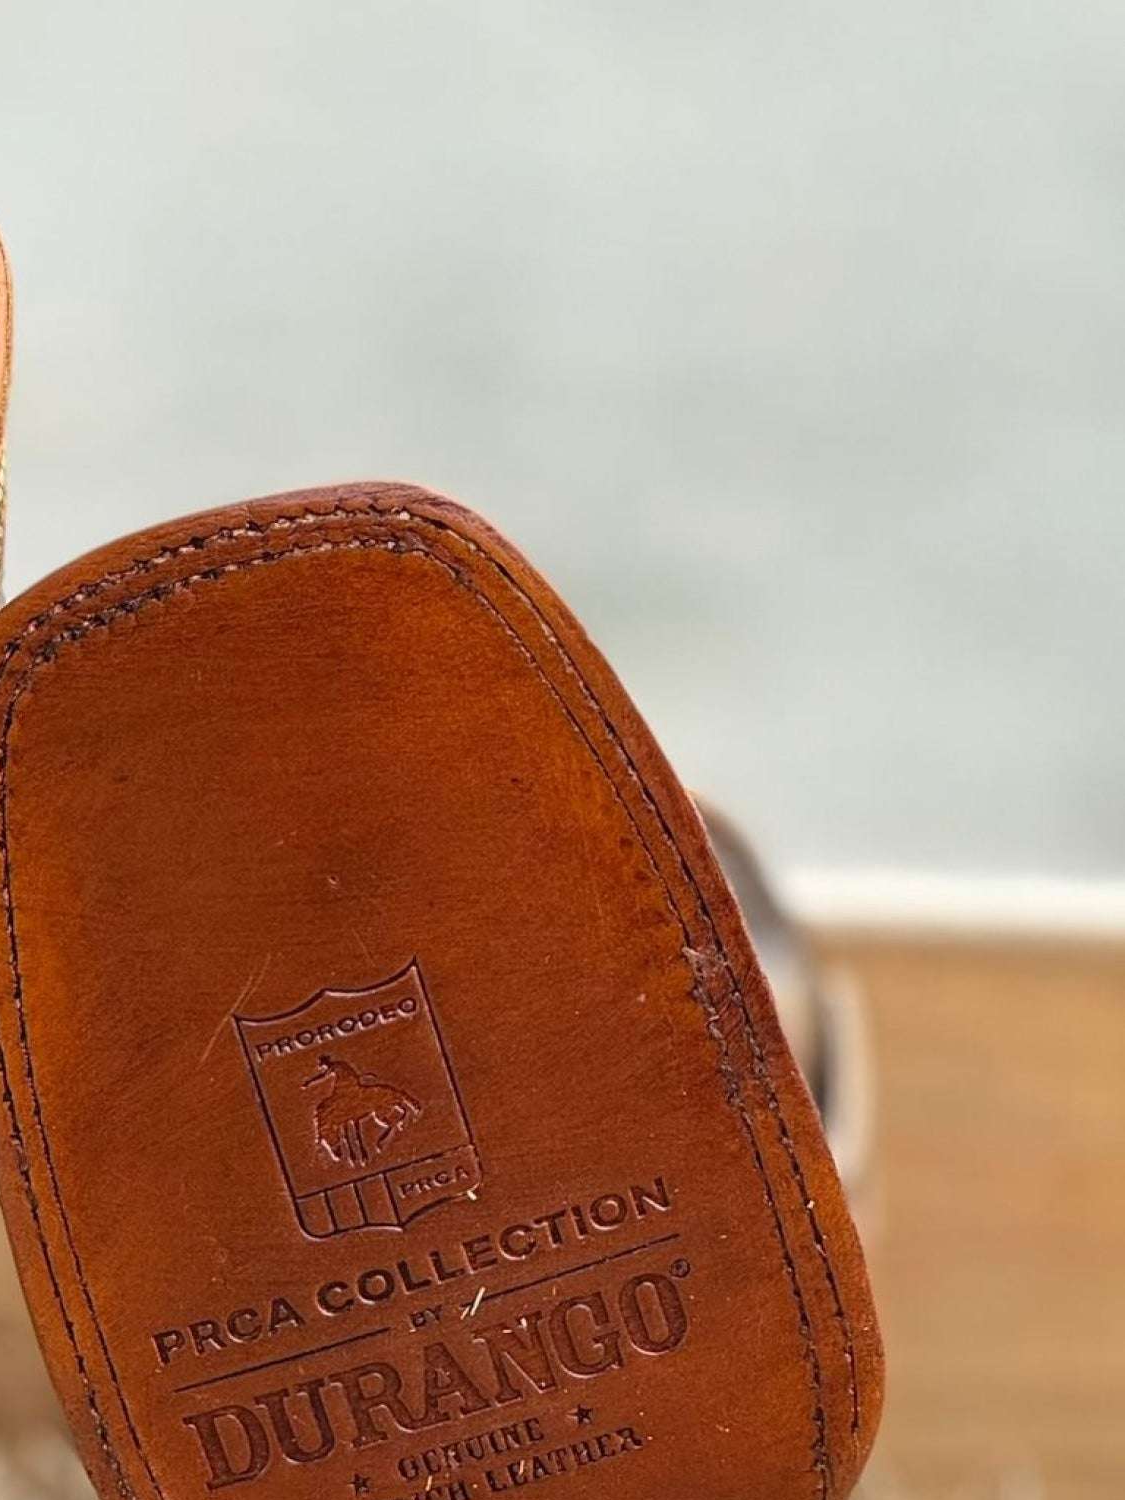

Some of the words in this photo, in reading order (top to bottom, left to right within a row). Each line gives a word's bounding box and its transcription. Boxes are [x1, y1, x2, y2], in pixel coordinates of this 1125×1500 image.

[253, 997, 417, 1062] PRORODEO
[400, 1166, 470, 1198] PRCA
[151, 1297, 306, 1369] PRCA
[316, 1177, 674, 1316] COLLECTION
[410, 1304, 444, 1331] BY
[397, 1417, 544, 1482] GENUINE
[485, 1426, 644, 1493] LEATHER
